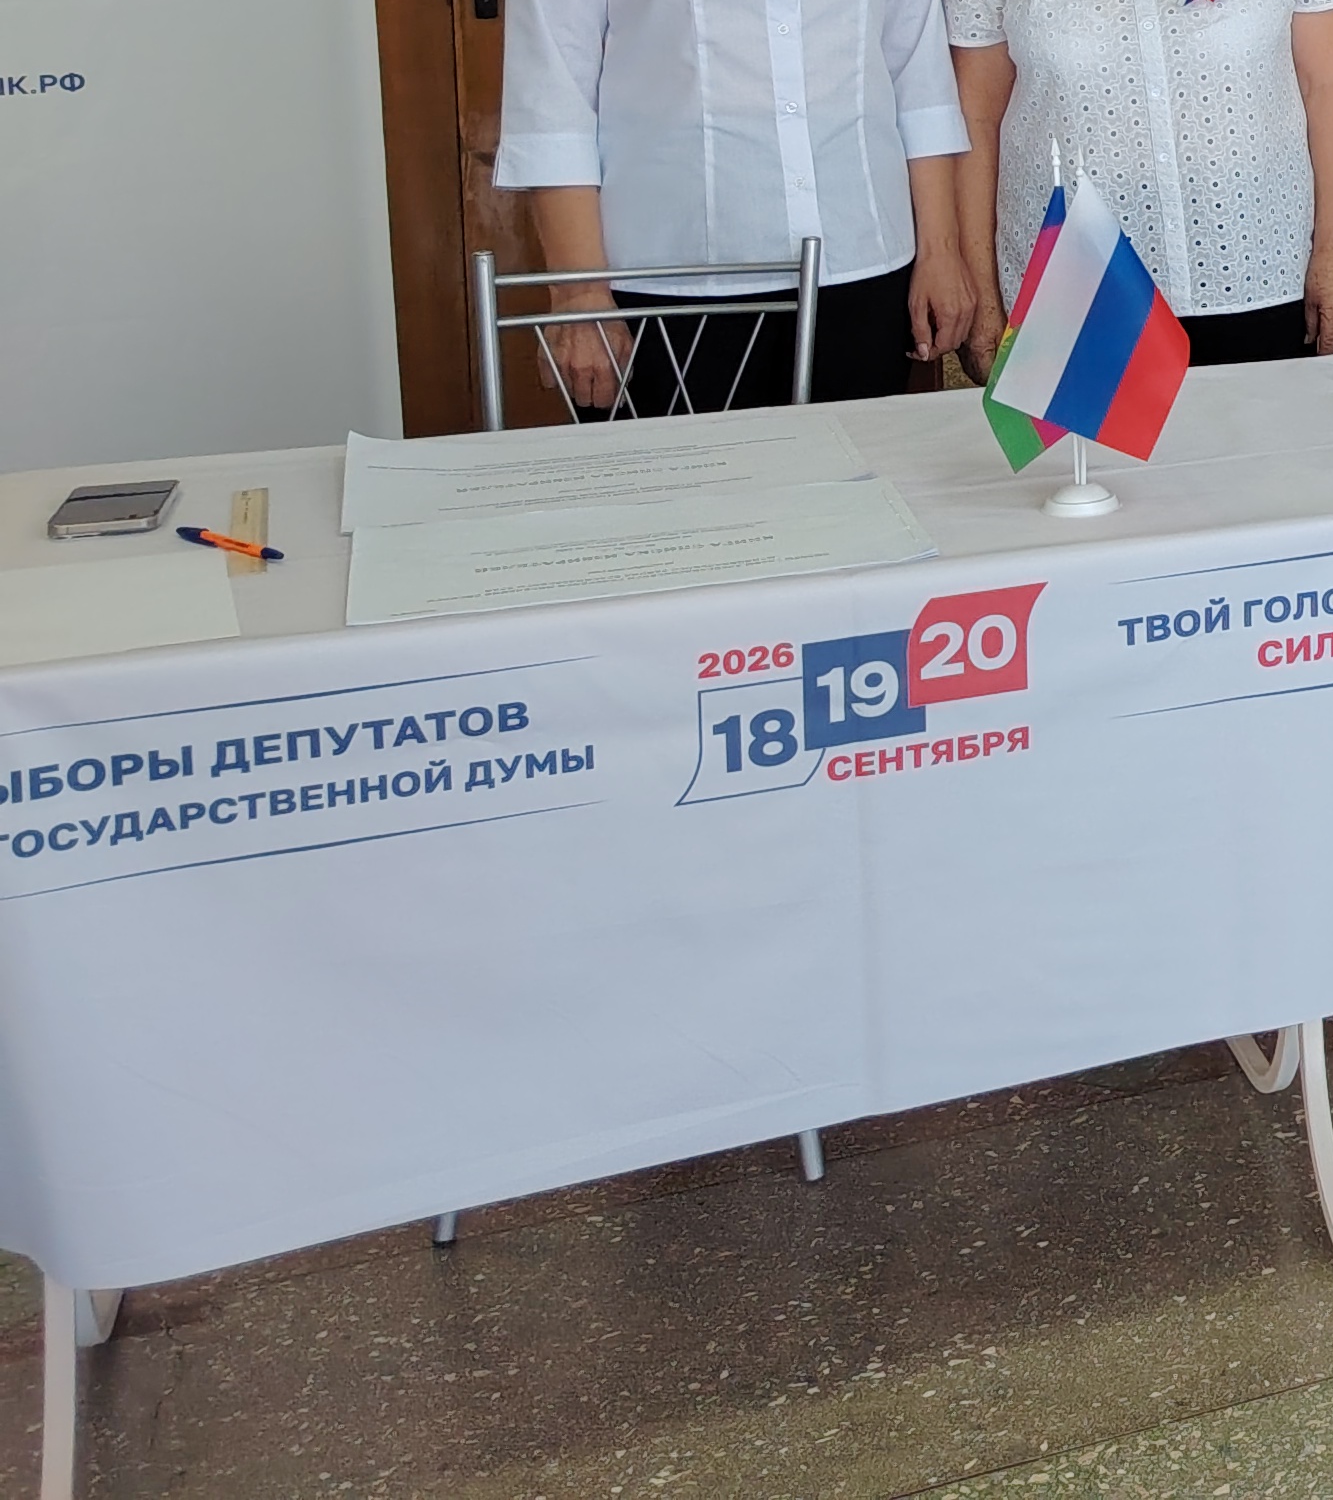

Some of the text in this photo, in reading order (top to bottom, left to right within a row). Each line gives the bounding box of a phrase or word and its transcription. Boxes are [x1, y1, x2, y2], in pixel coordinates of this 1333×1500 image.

[1117, 596, 1230, 646] ТВОЙ
[697, 642, 795, 679] 2026
[712, 614, 1018, 773] 18 19 20
[210, 701, 530, 778] ДЕПУТАТОВ
[827, 726, 1030, 782] СЕНТЯБРЯ
[0, 744, 595, 859] ОСУДАРСТВЕННОЙ ДУМЫ
